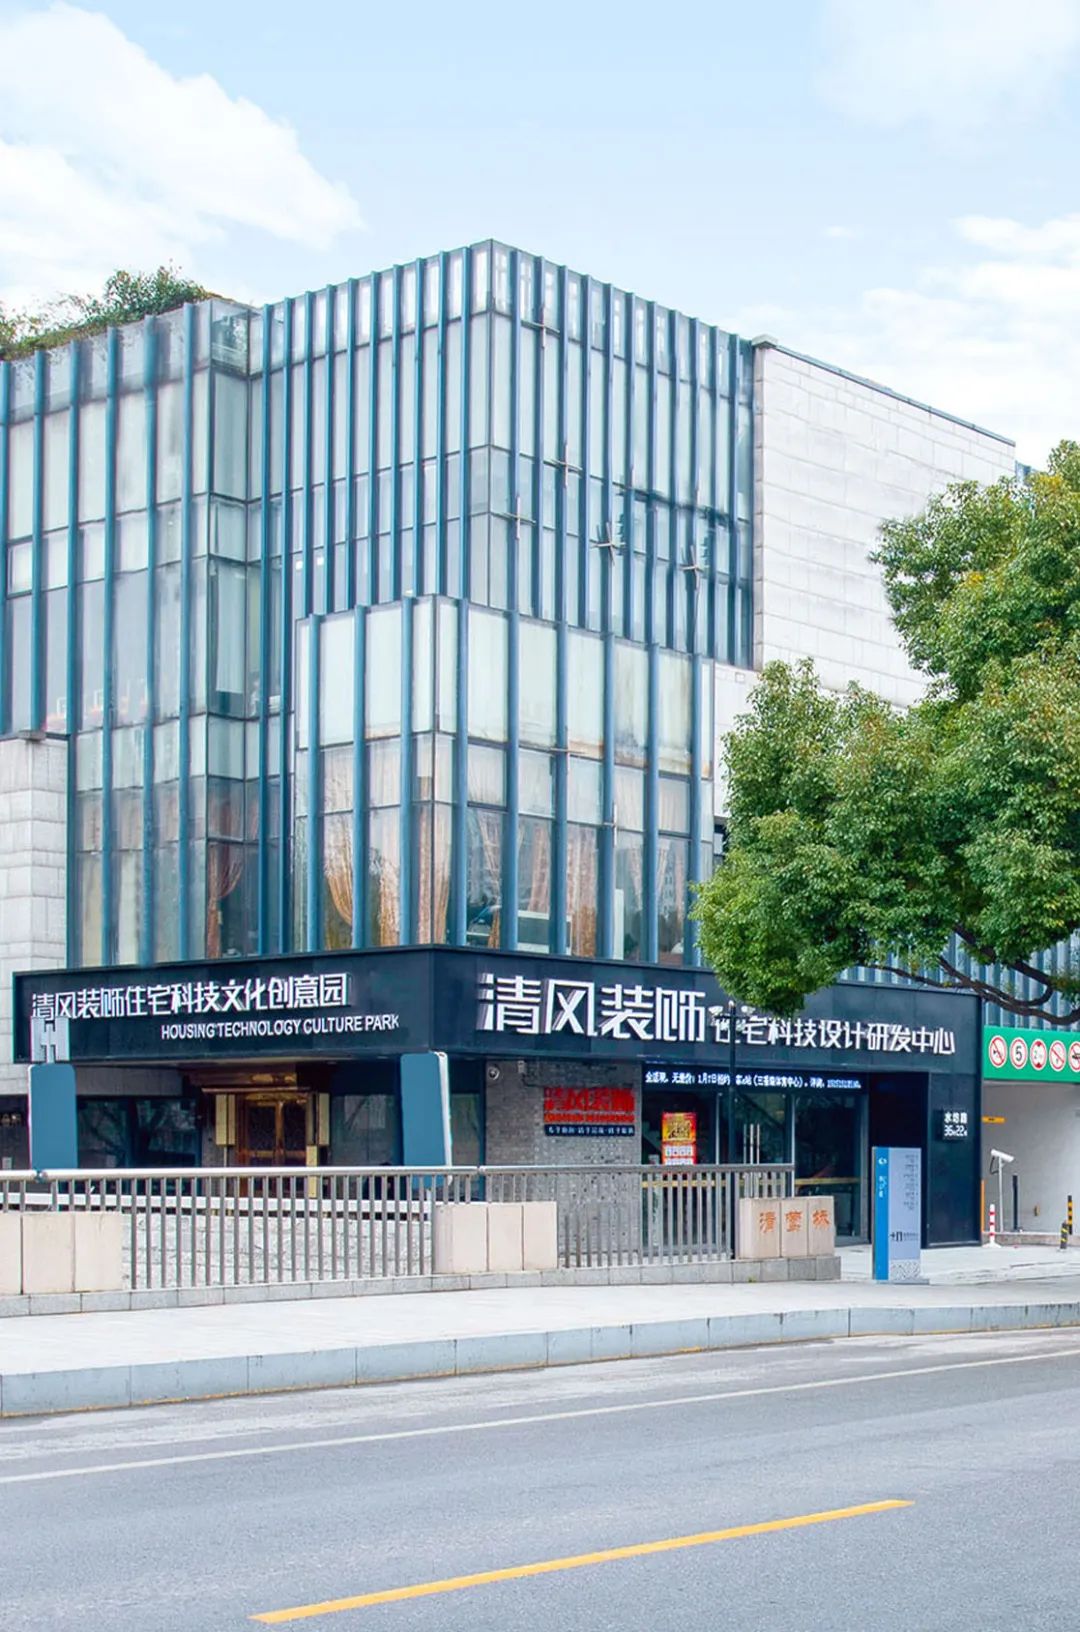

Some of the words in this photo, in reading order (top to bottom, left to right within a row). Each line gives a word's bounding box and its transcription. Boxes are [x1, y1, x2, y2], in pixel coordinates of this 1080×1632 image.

[32, 973, 349, 1020] 清风装饰住宅科技文化创意园
[477, 973, 706, 1042] 清风装饰
[161, 1022, 215, 1040] HOUSING
[218, 1019, 301, 1038] TECHNOLOGY
[303, 1015, 363, 1035] CULTURE
[365, 1014, 400, 1032] PARK
[1015, 1045, 1023, 1062] 5
